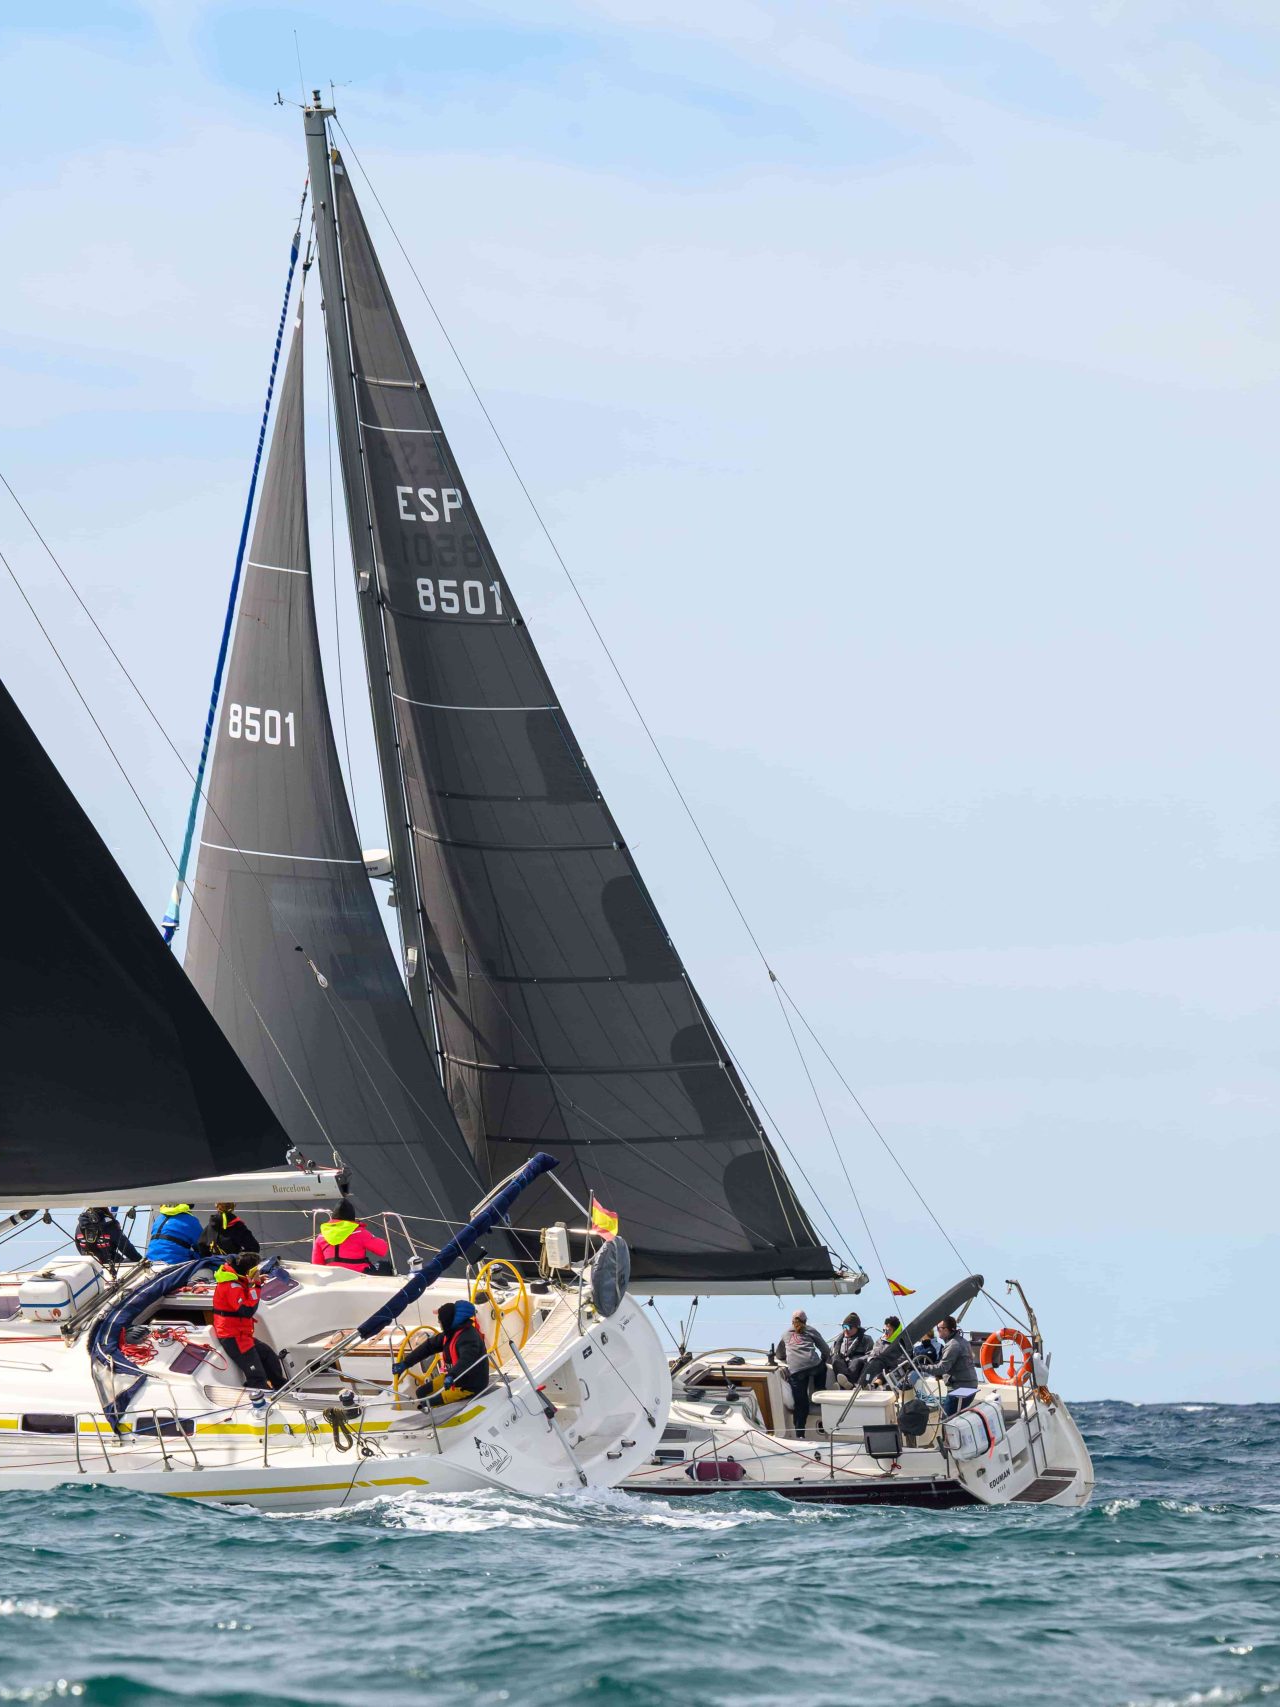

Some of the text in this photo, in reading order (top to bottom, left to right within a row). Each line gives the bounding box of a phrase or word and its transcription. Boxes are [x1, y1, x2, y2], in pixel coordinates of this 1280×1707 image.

[396, 485, 463, 522] ESP
[416, 577, 503, 615] 8501
[228, 703, 295, 748] 8501
[272, 1184, 311, 1193] Barcelona
